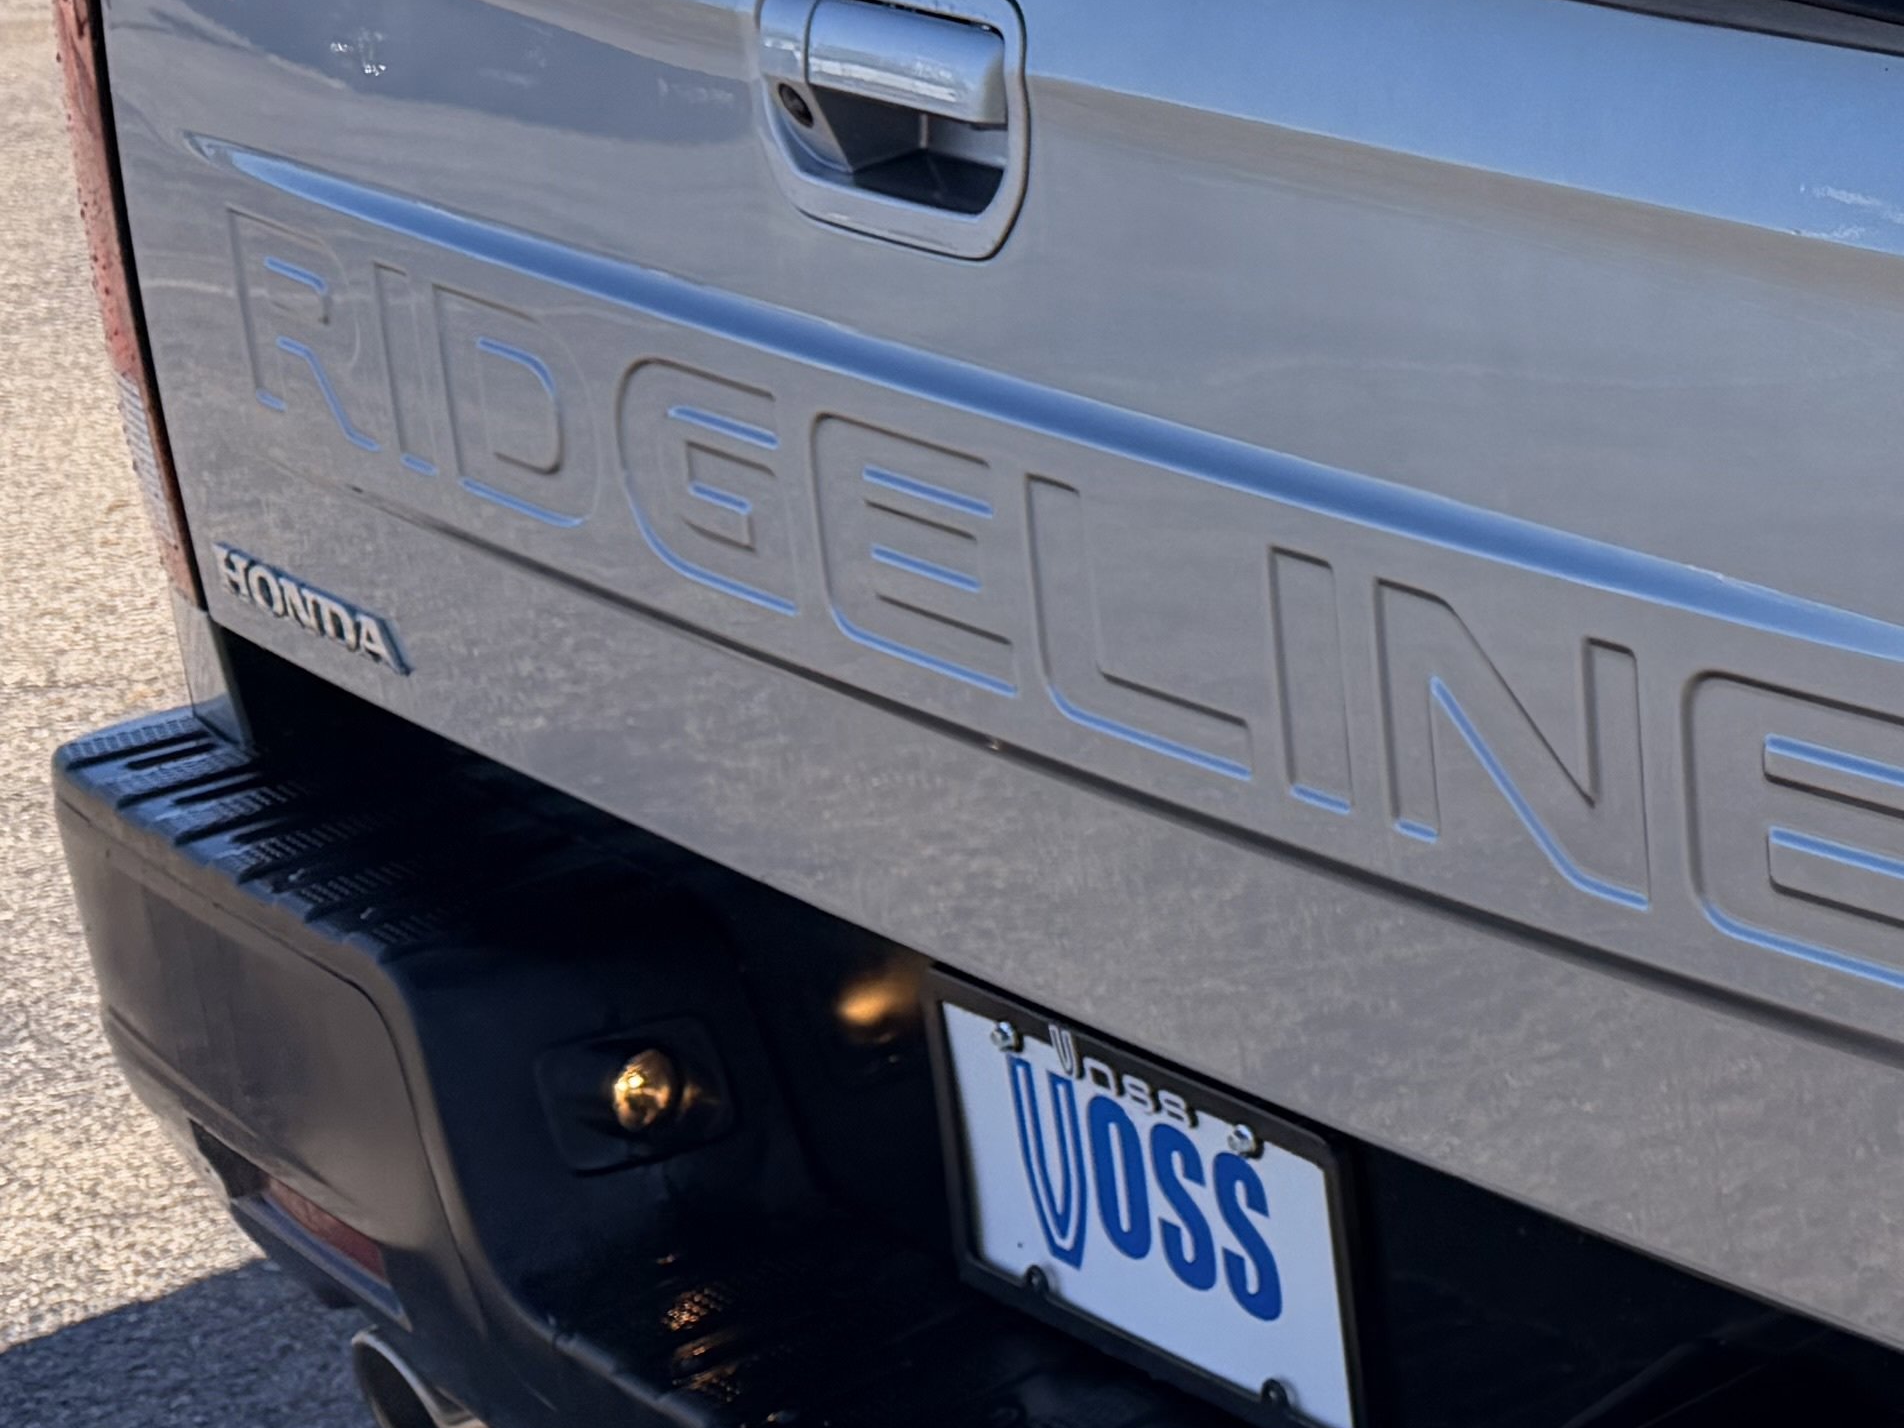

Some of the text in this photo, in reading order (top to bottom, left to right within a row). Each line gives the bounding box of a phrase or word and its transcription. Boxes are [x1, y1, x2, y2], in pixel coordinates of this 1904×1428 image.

[212, 540, 413, 677] HONDA
[1048, 1023, 1198, 1128] VOSS
[1006, 1053, 1283, 1322] VOSS
